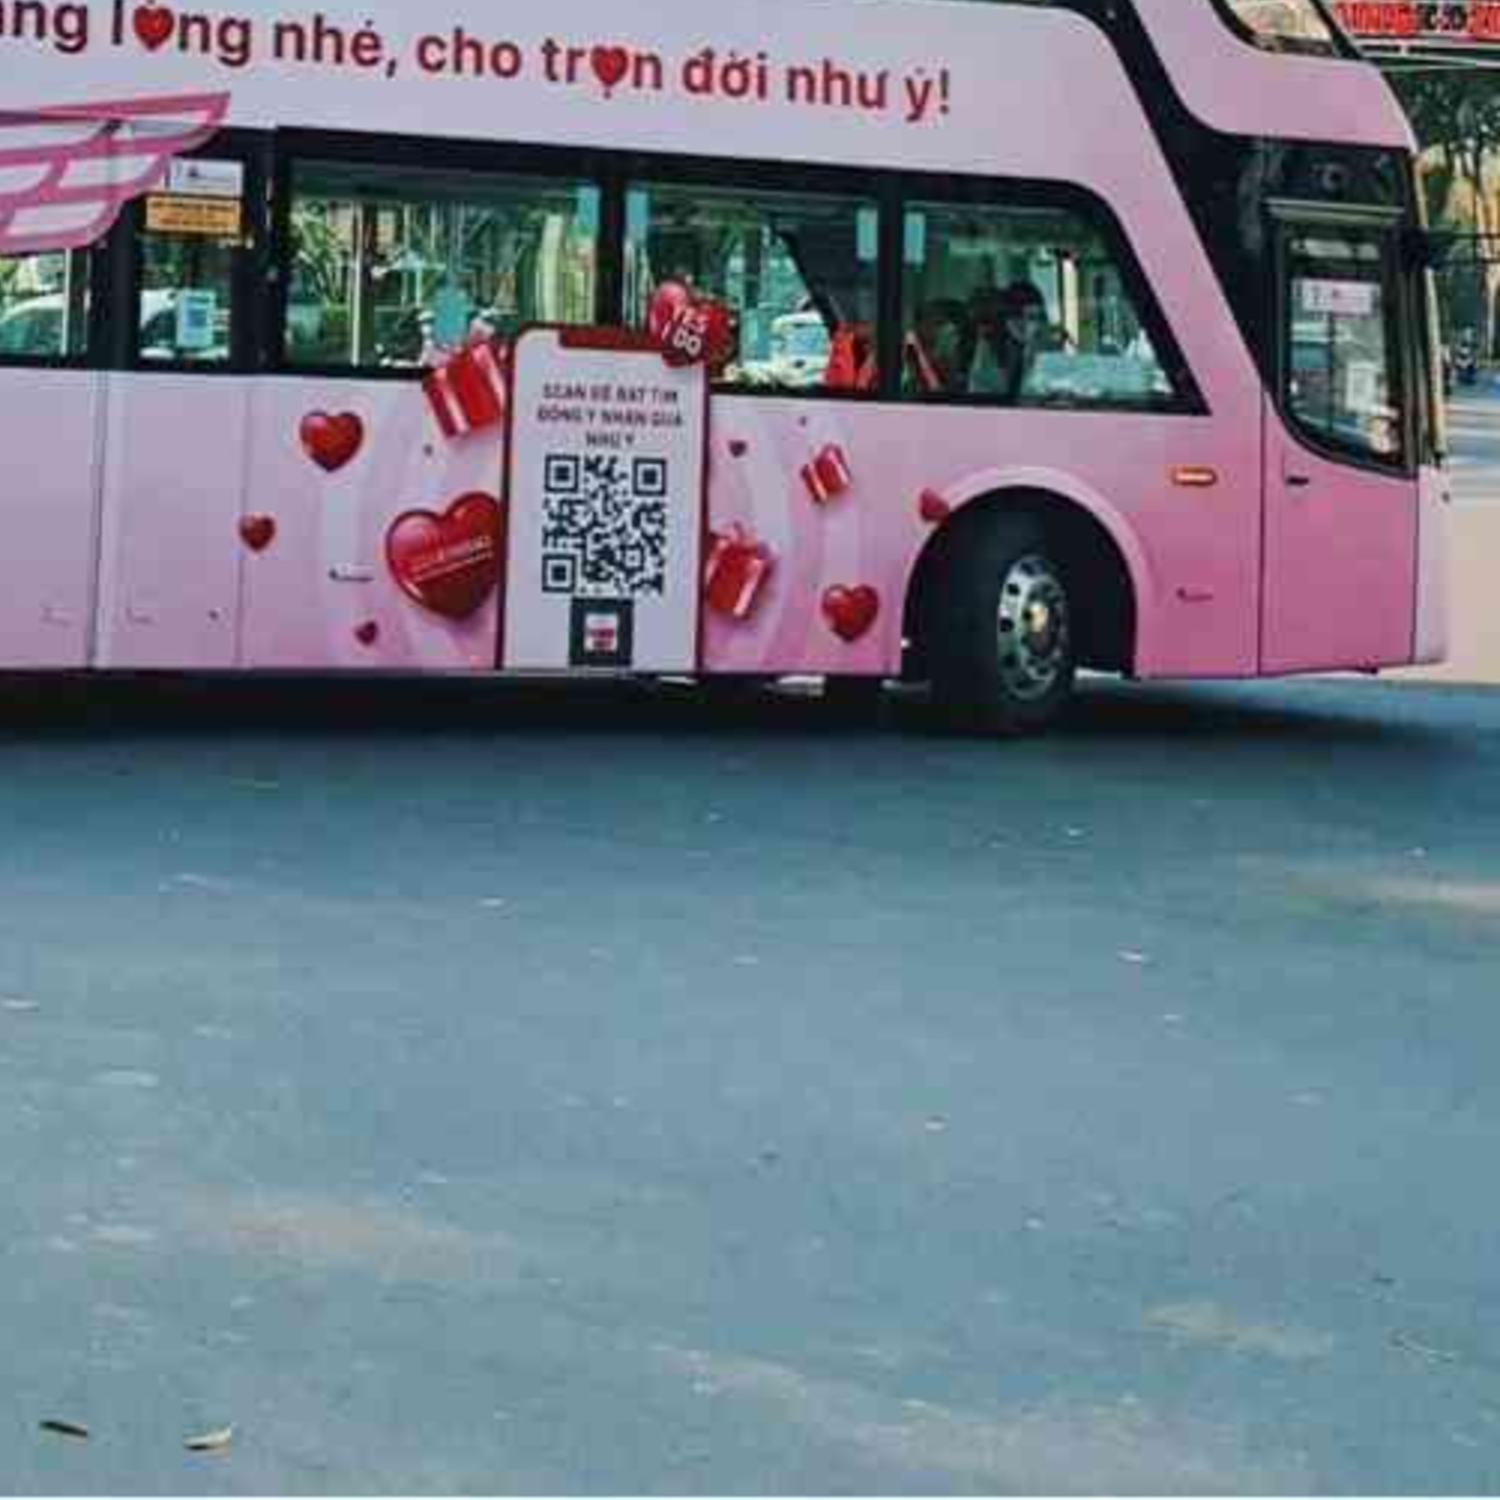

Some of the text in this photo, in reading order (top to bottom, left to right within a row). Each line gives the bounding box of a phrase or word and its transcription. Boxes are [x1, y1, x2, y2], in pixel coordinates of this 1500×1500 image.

[273, 15, 398, 78] nhé,
[415, 27, 522, 79] cho
[682, 47, 768, 101] đời
[786, 58, 889, 109] như
